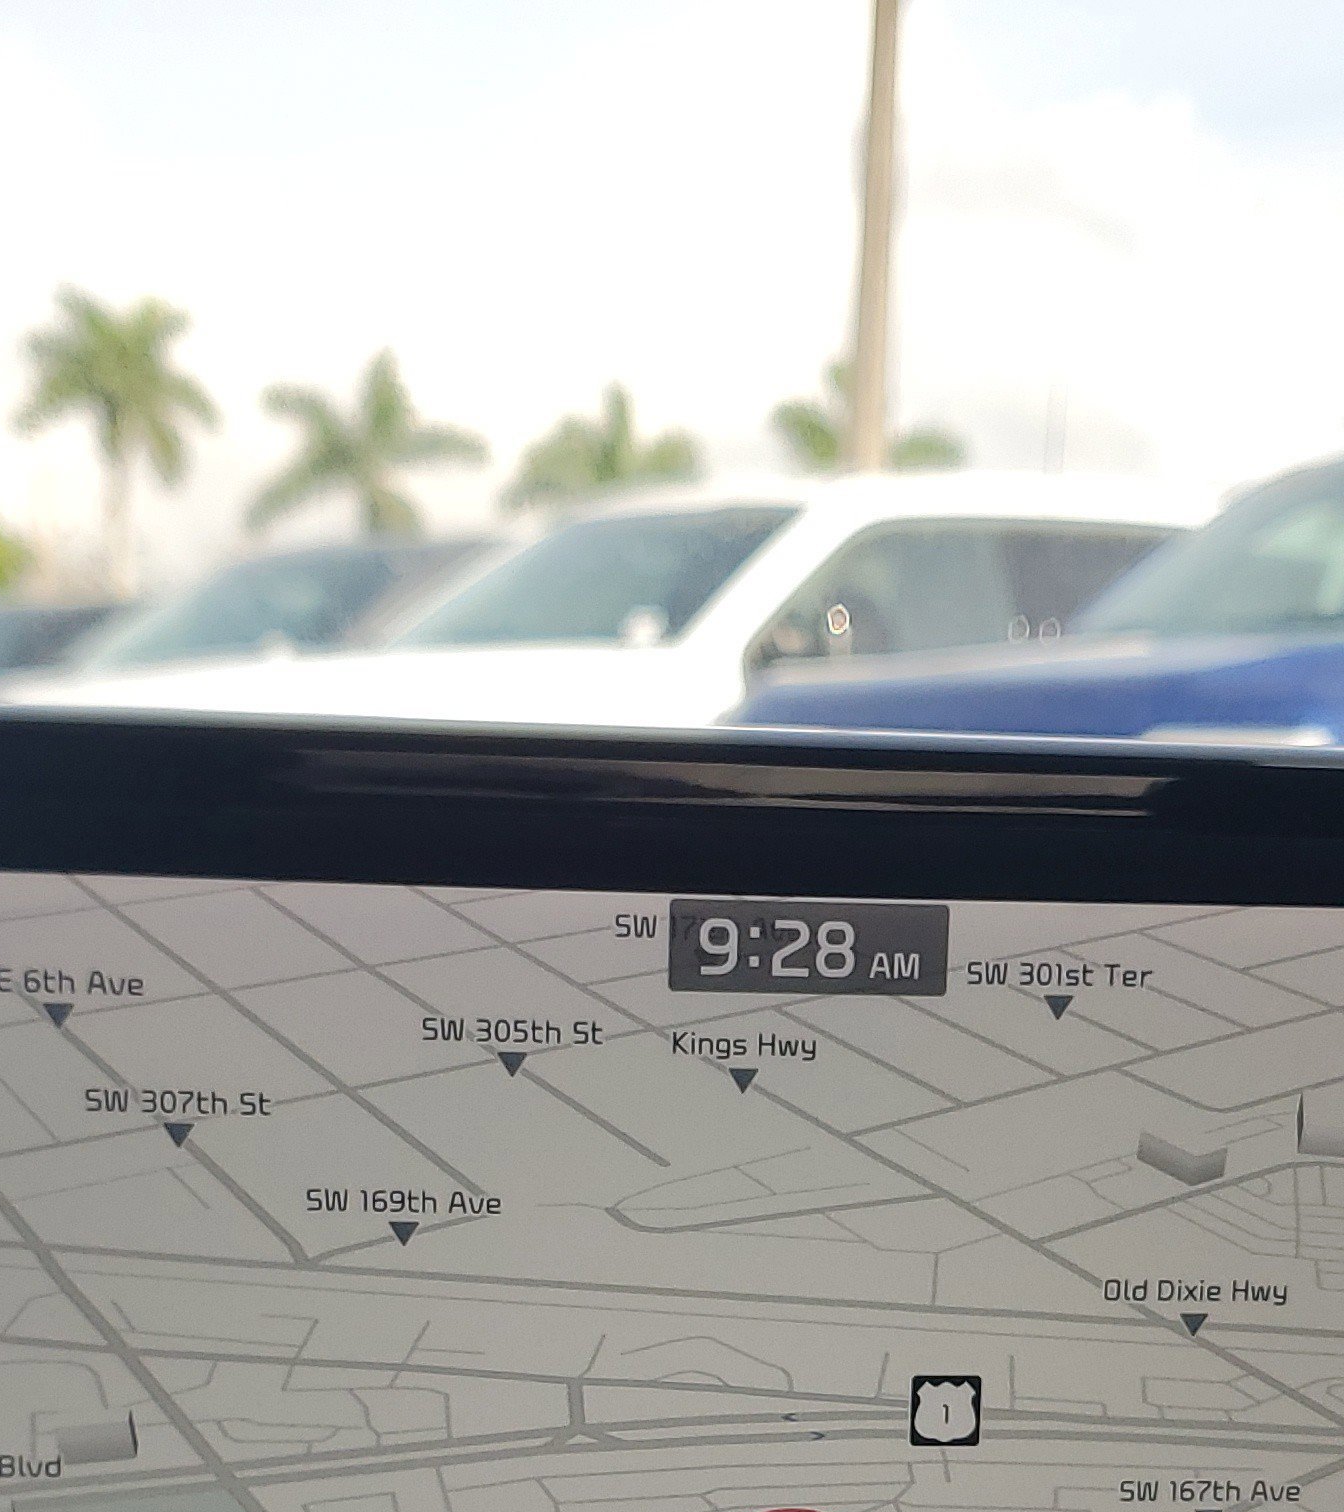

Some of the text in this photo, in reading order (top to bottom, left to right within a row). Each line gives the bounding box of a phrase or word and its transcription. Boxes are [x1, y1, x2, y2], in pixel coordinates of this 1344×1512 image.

[614, 914, 657, 938] SW
[699, 917, 856, 979] 9:28
[869, 953, 920, 979] AM
[23, 968, 75, 995] 6th
[87, 971, 145, 997] Ave
[966, 961, 1153, 988] SW 301st Ter
[421, 1018, 604, 1045] SW 305th St
[672, 1031, 817, 1061] Kings Hwy
[84, 1088, 272, 1116] SW 307th St
[305, 1189, 502, 1216] SW 169th Ave
[1103, 1278, 1288, 1306] Old Dixie Hwy
[942, 1403, 950, 1425] 1
[0, 1455, 62, 1479] Blvd
[1119, 1481, 1301, 1504] SW 167th Ave
